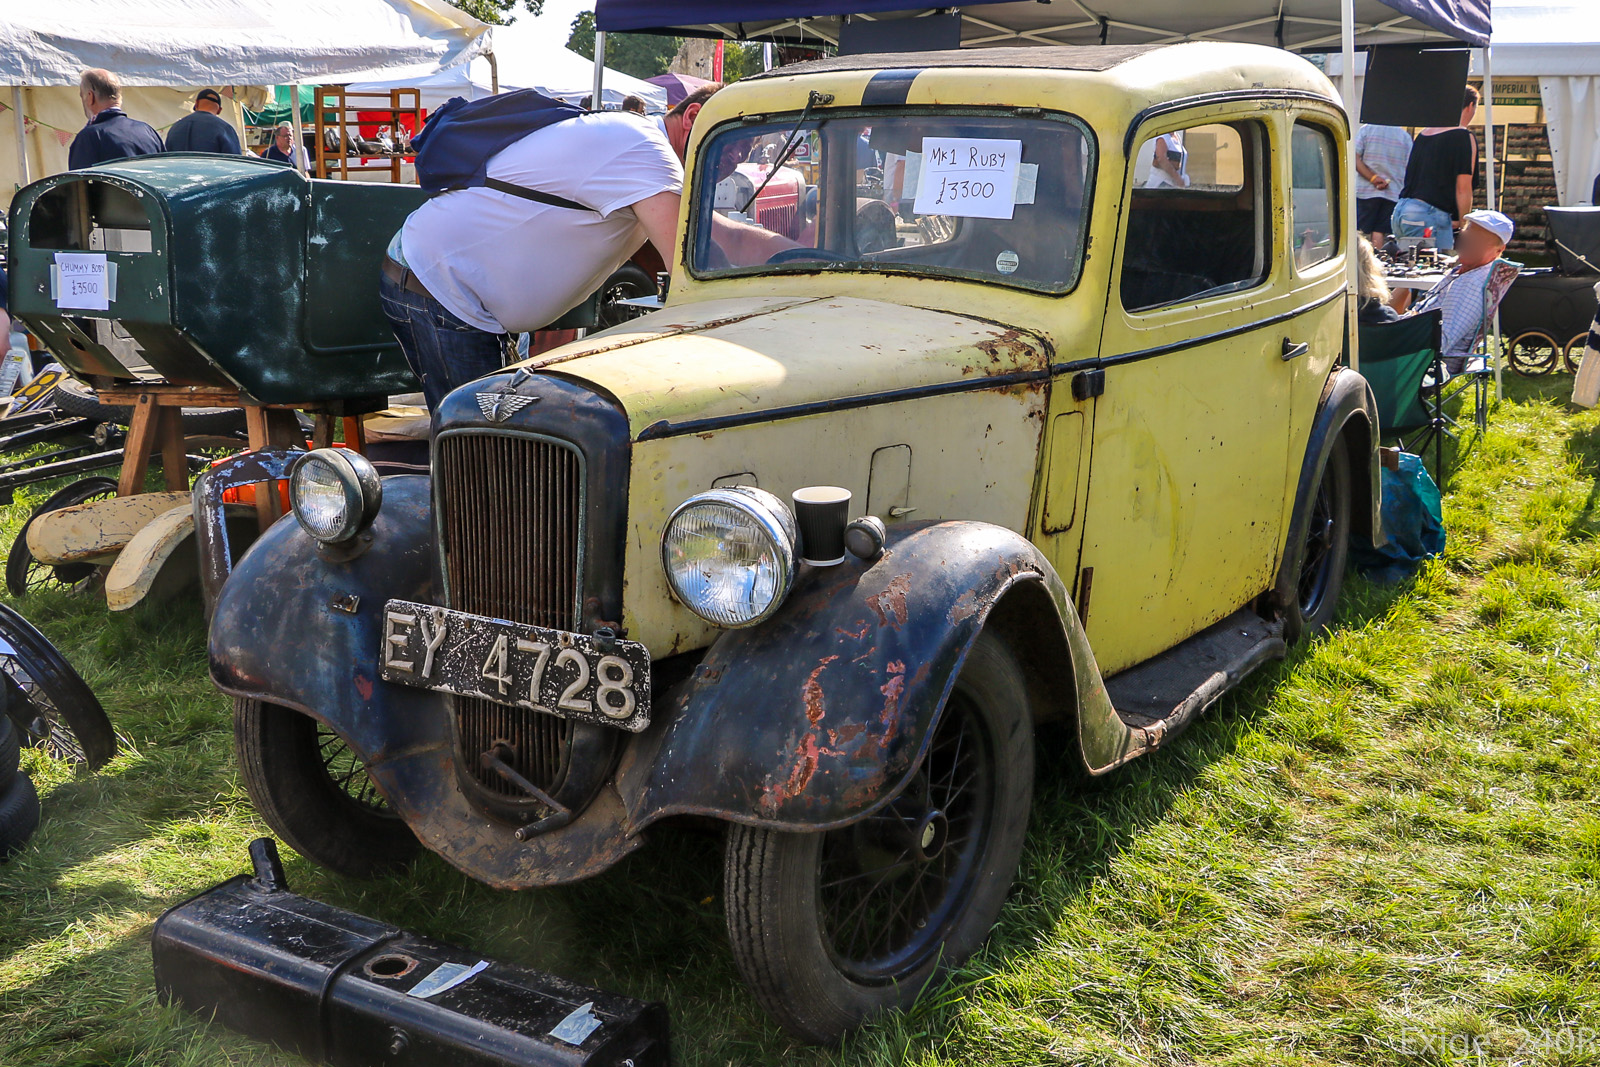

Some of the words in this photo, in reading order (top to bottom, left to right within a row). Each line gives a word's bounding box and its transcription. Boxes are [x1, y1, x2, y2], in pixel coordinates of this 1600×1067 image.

[1492, 84, 1528, 94] IMPERIAL
[968, 147, 1006, 168] RUBY
[936, 177, 995, 205] £3300
[61, 262, 88, 273] CHUMMY
[92, 263, 105, 273] BODY
[72, 280, 97, 295] £3500
[384, 611, 447, 679] EY
[482, 633, 636, 720] 4728
